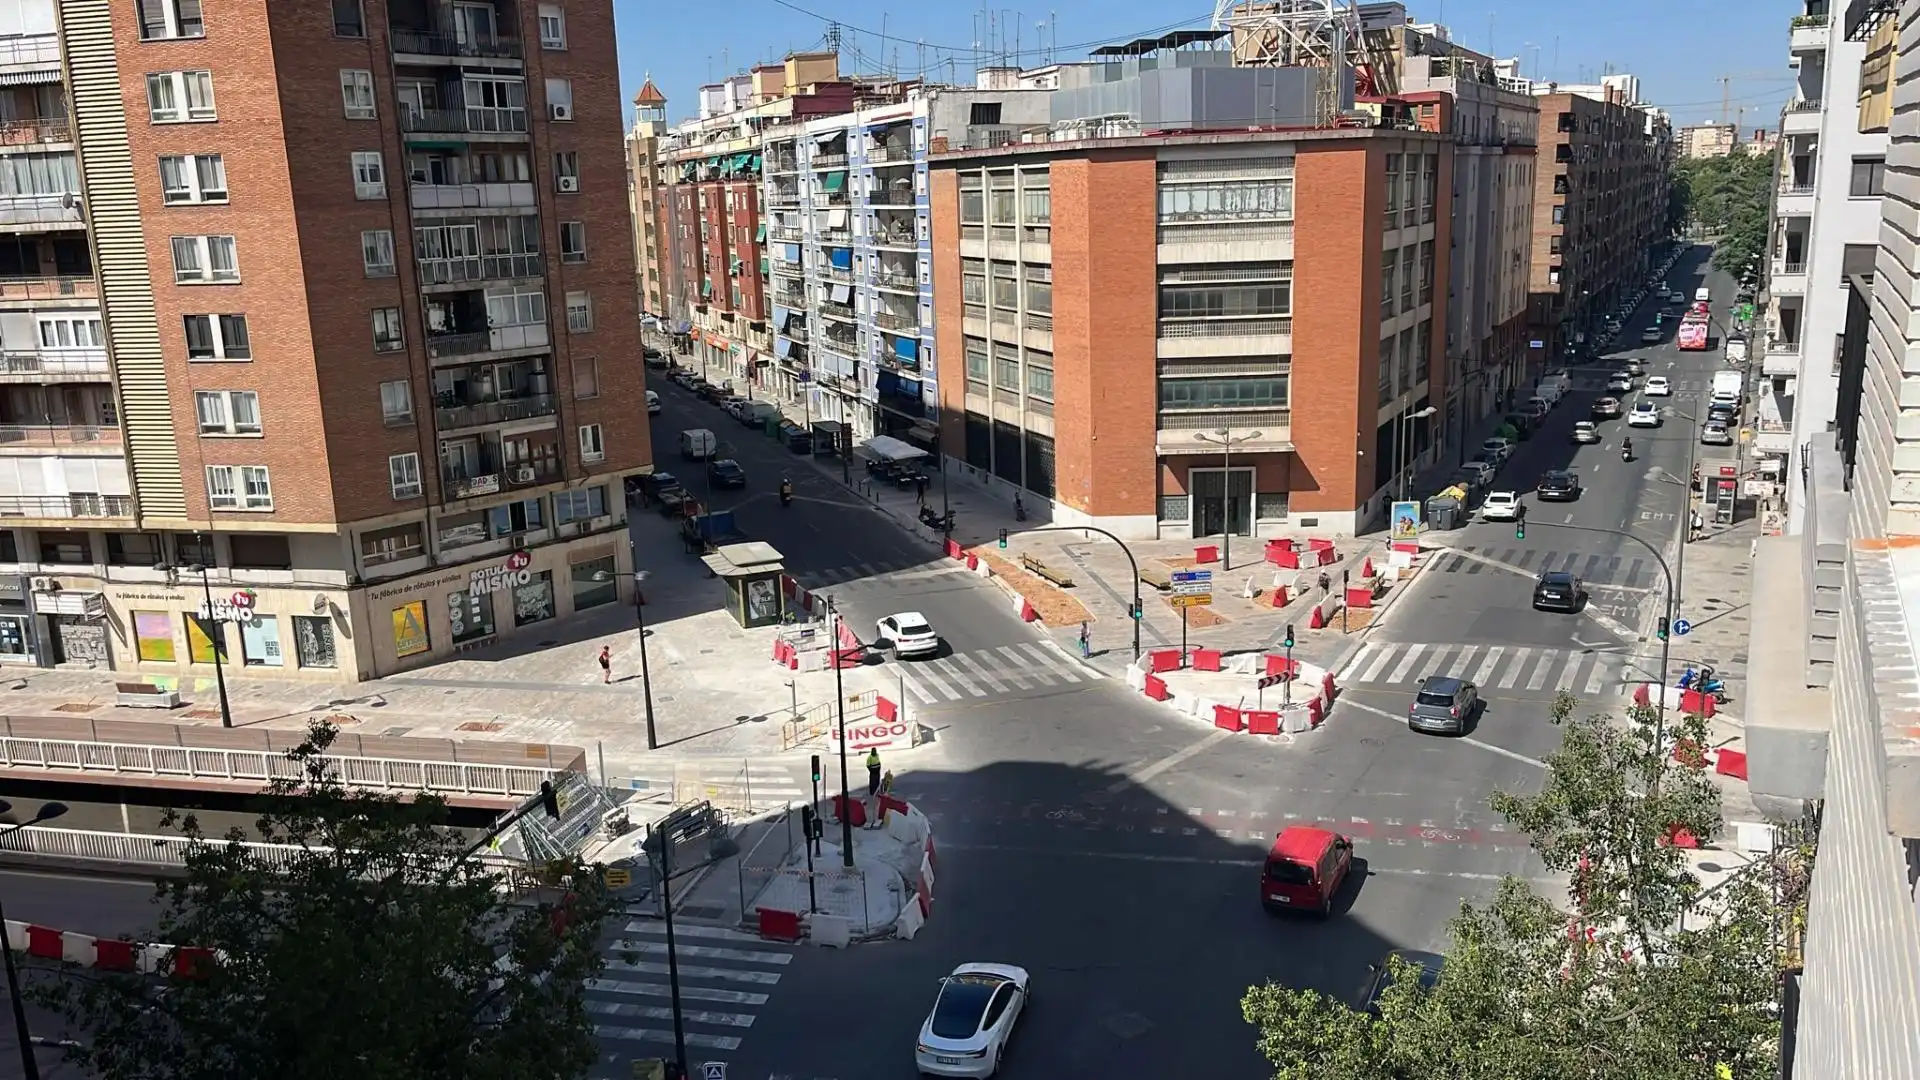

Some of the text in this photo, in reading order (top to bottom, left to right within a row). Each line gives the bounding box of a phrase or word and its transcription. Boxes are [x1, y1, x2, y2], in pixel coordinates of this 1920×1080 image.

[1641, 511, 1675, 520] EMT
[471, 555, 528, 580] ROTULA tu
[470, 569, 531, 597] MISMO
[200, 592, 249, 607] RTULA tu
[198, 606, 253, 621] MISMO
[832, 724, 907, 741] BINGO
